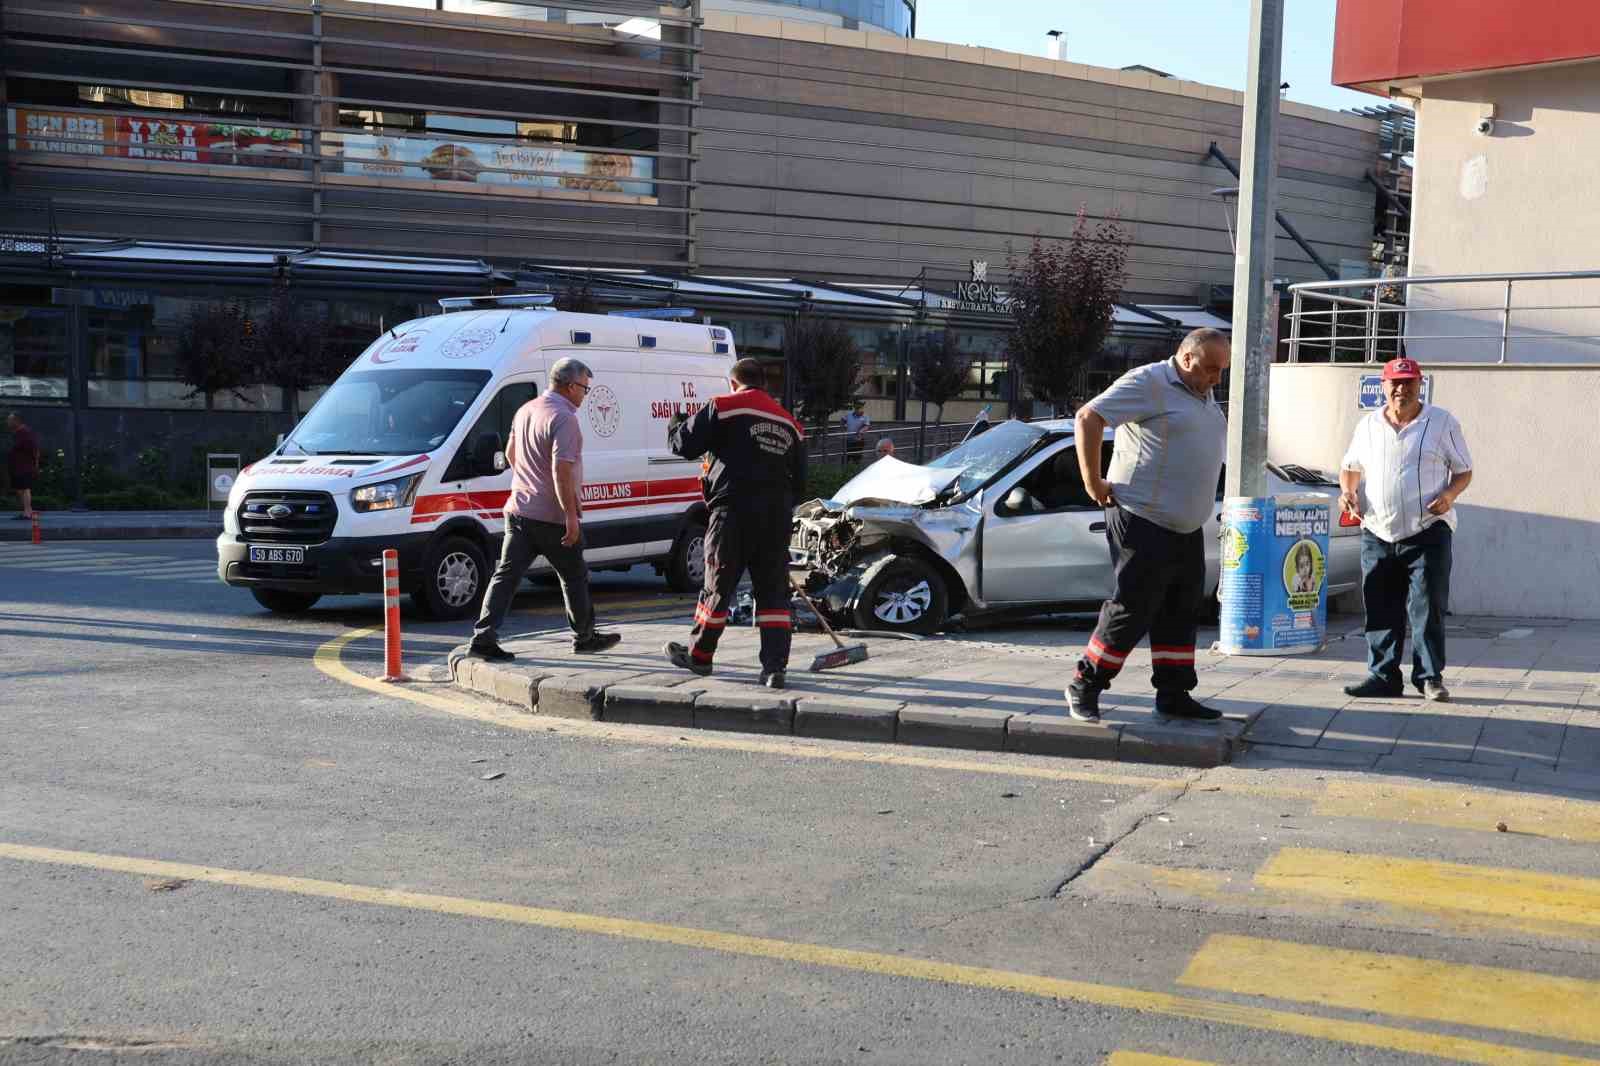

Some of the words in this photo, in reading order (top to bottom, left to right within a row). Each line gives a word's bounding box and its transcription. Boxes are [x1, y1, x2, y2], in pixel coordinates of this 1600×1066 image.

[681, 382, 697, 398] T.C.
[268, 549, 283, 561] ABS
[285, 550, 301, 562] 670
